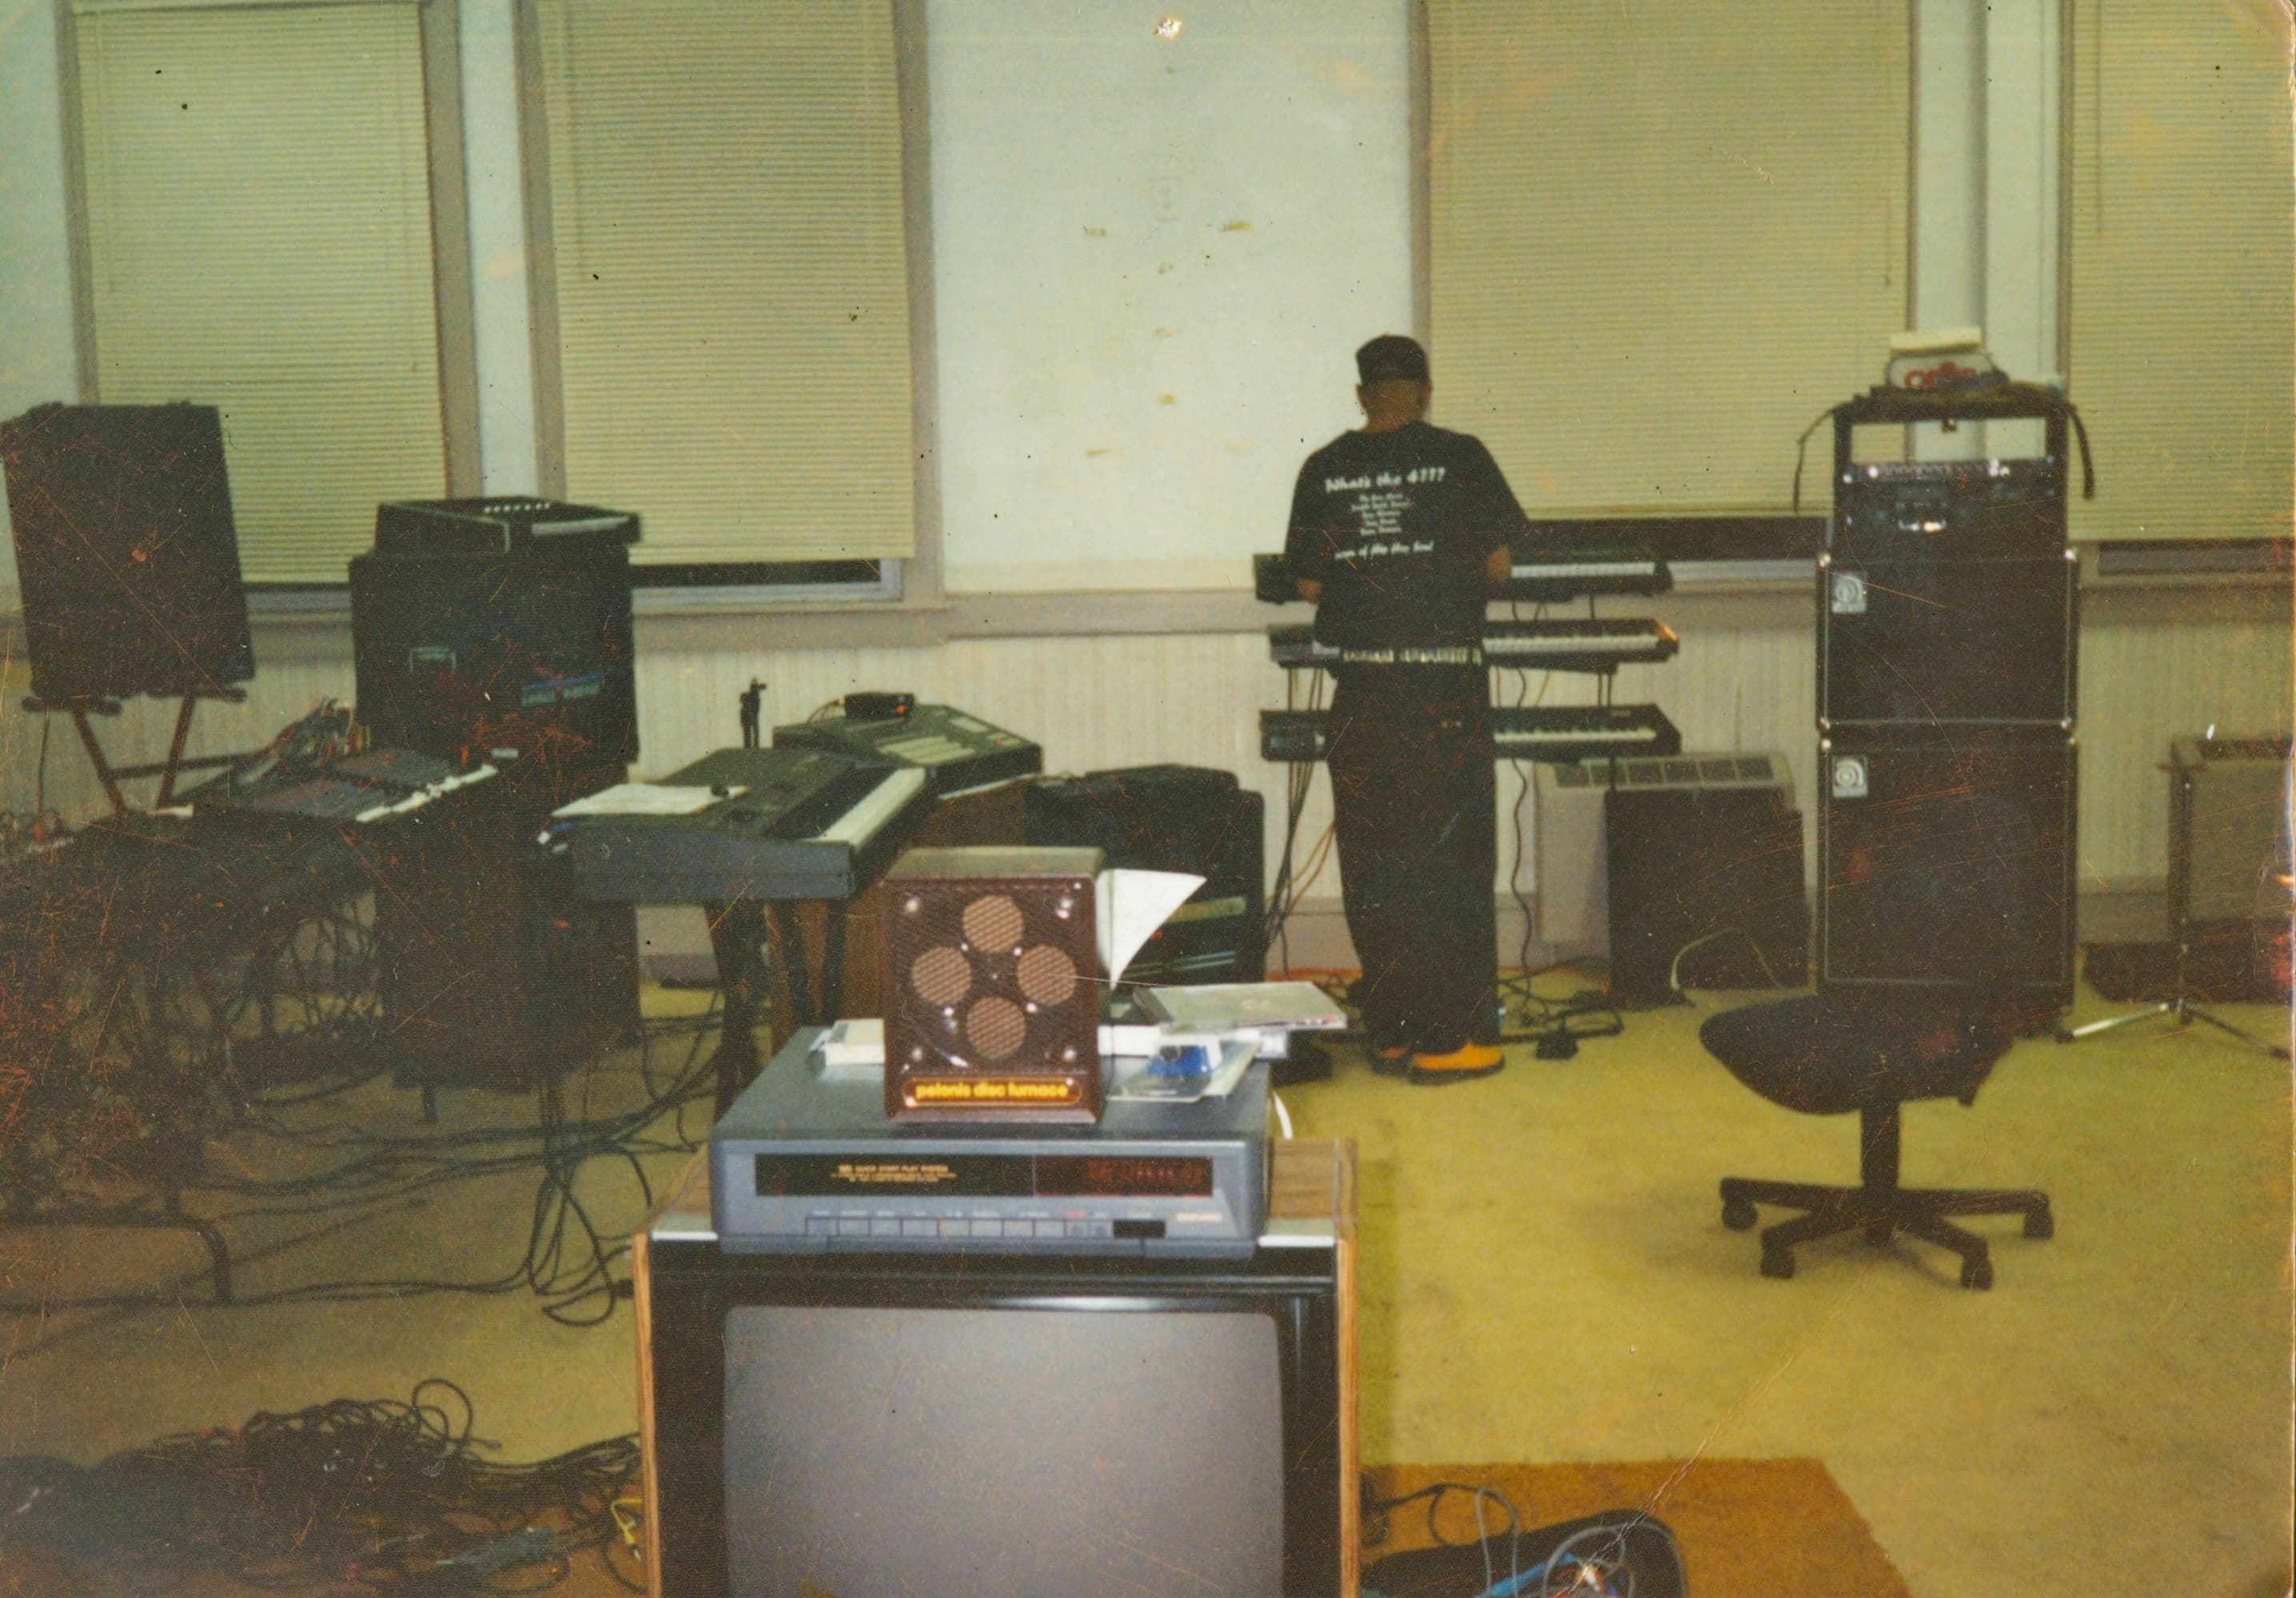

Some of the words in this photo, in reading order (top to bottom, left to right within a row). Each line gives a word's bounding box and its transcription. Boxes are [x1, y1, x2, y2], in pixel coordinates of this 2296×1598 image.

[1377, 472, 1401, 487] the
[973, 1082, 1006, 1098] disc
[1007, 1082, 1069, 1098] furnace
